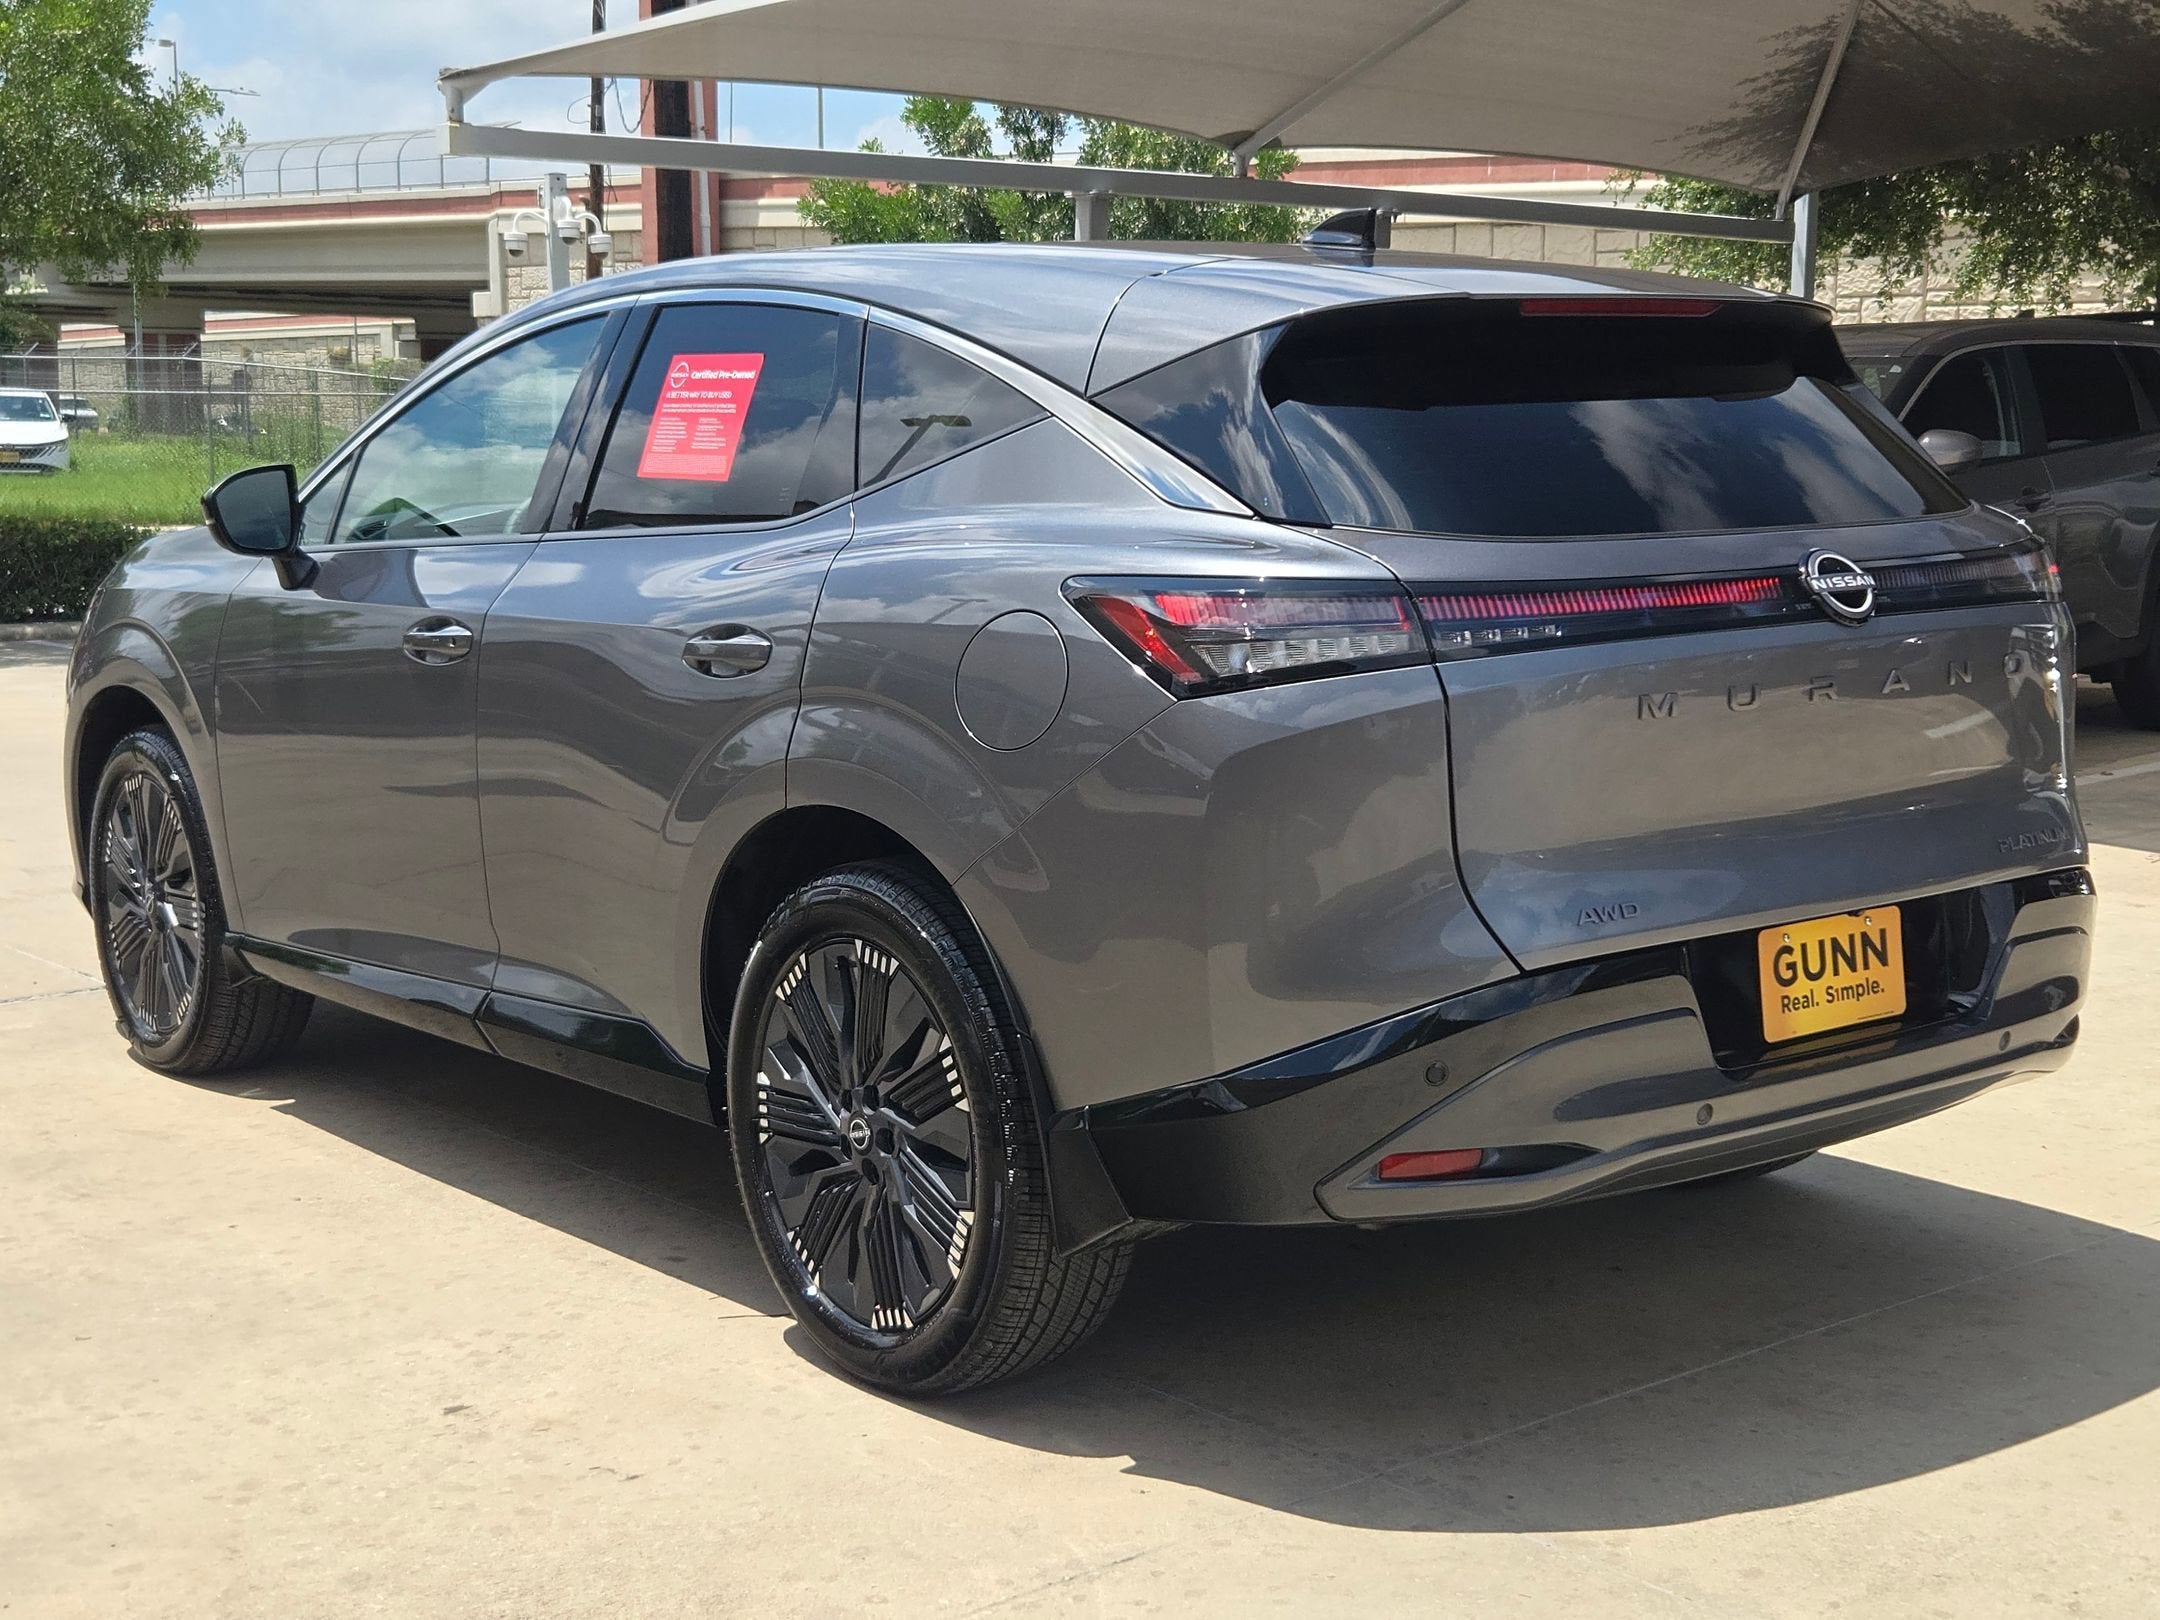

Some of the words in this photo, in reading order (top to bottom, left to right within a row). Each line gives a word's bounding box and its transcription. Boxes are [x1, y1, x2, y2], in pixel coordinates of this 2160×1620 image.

[691, 370, 718, 379] Certified
[719, 370, 756, 379] Pre-Owned
[1811, 575, 1876, 590] NISSAN
[1638, 650, 2022, 721] MURANO
[1998, 827, 2070, 853] PLATINUM
[1577, 903, 1639, 927] AWD
[1773, 928, 1889, 988] GUNN
[1780, 988, 1819, 1014] Real.
